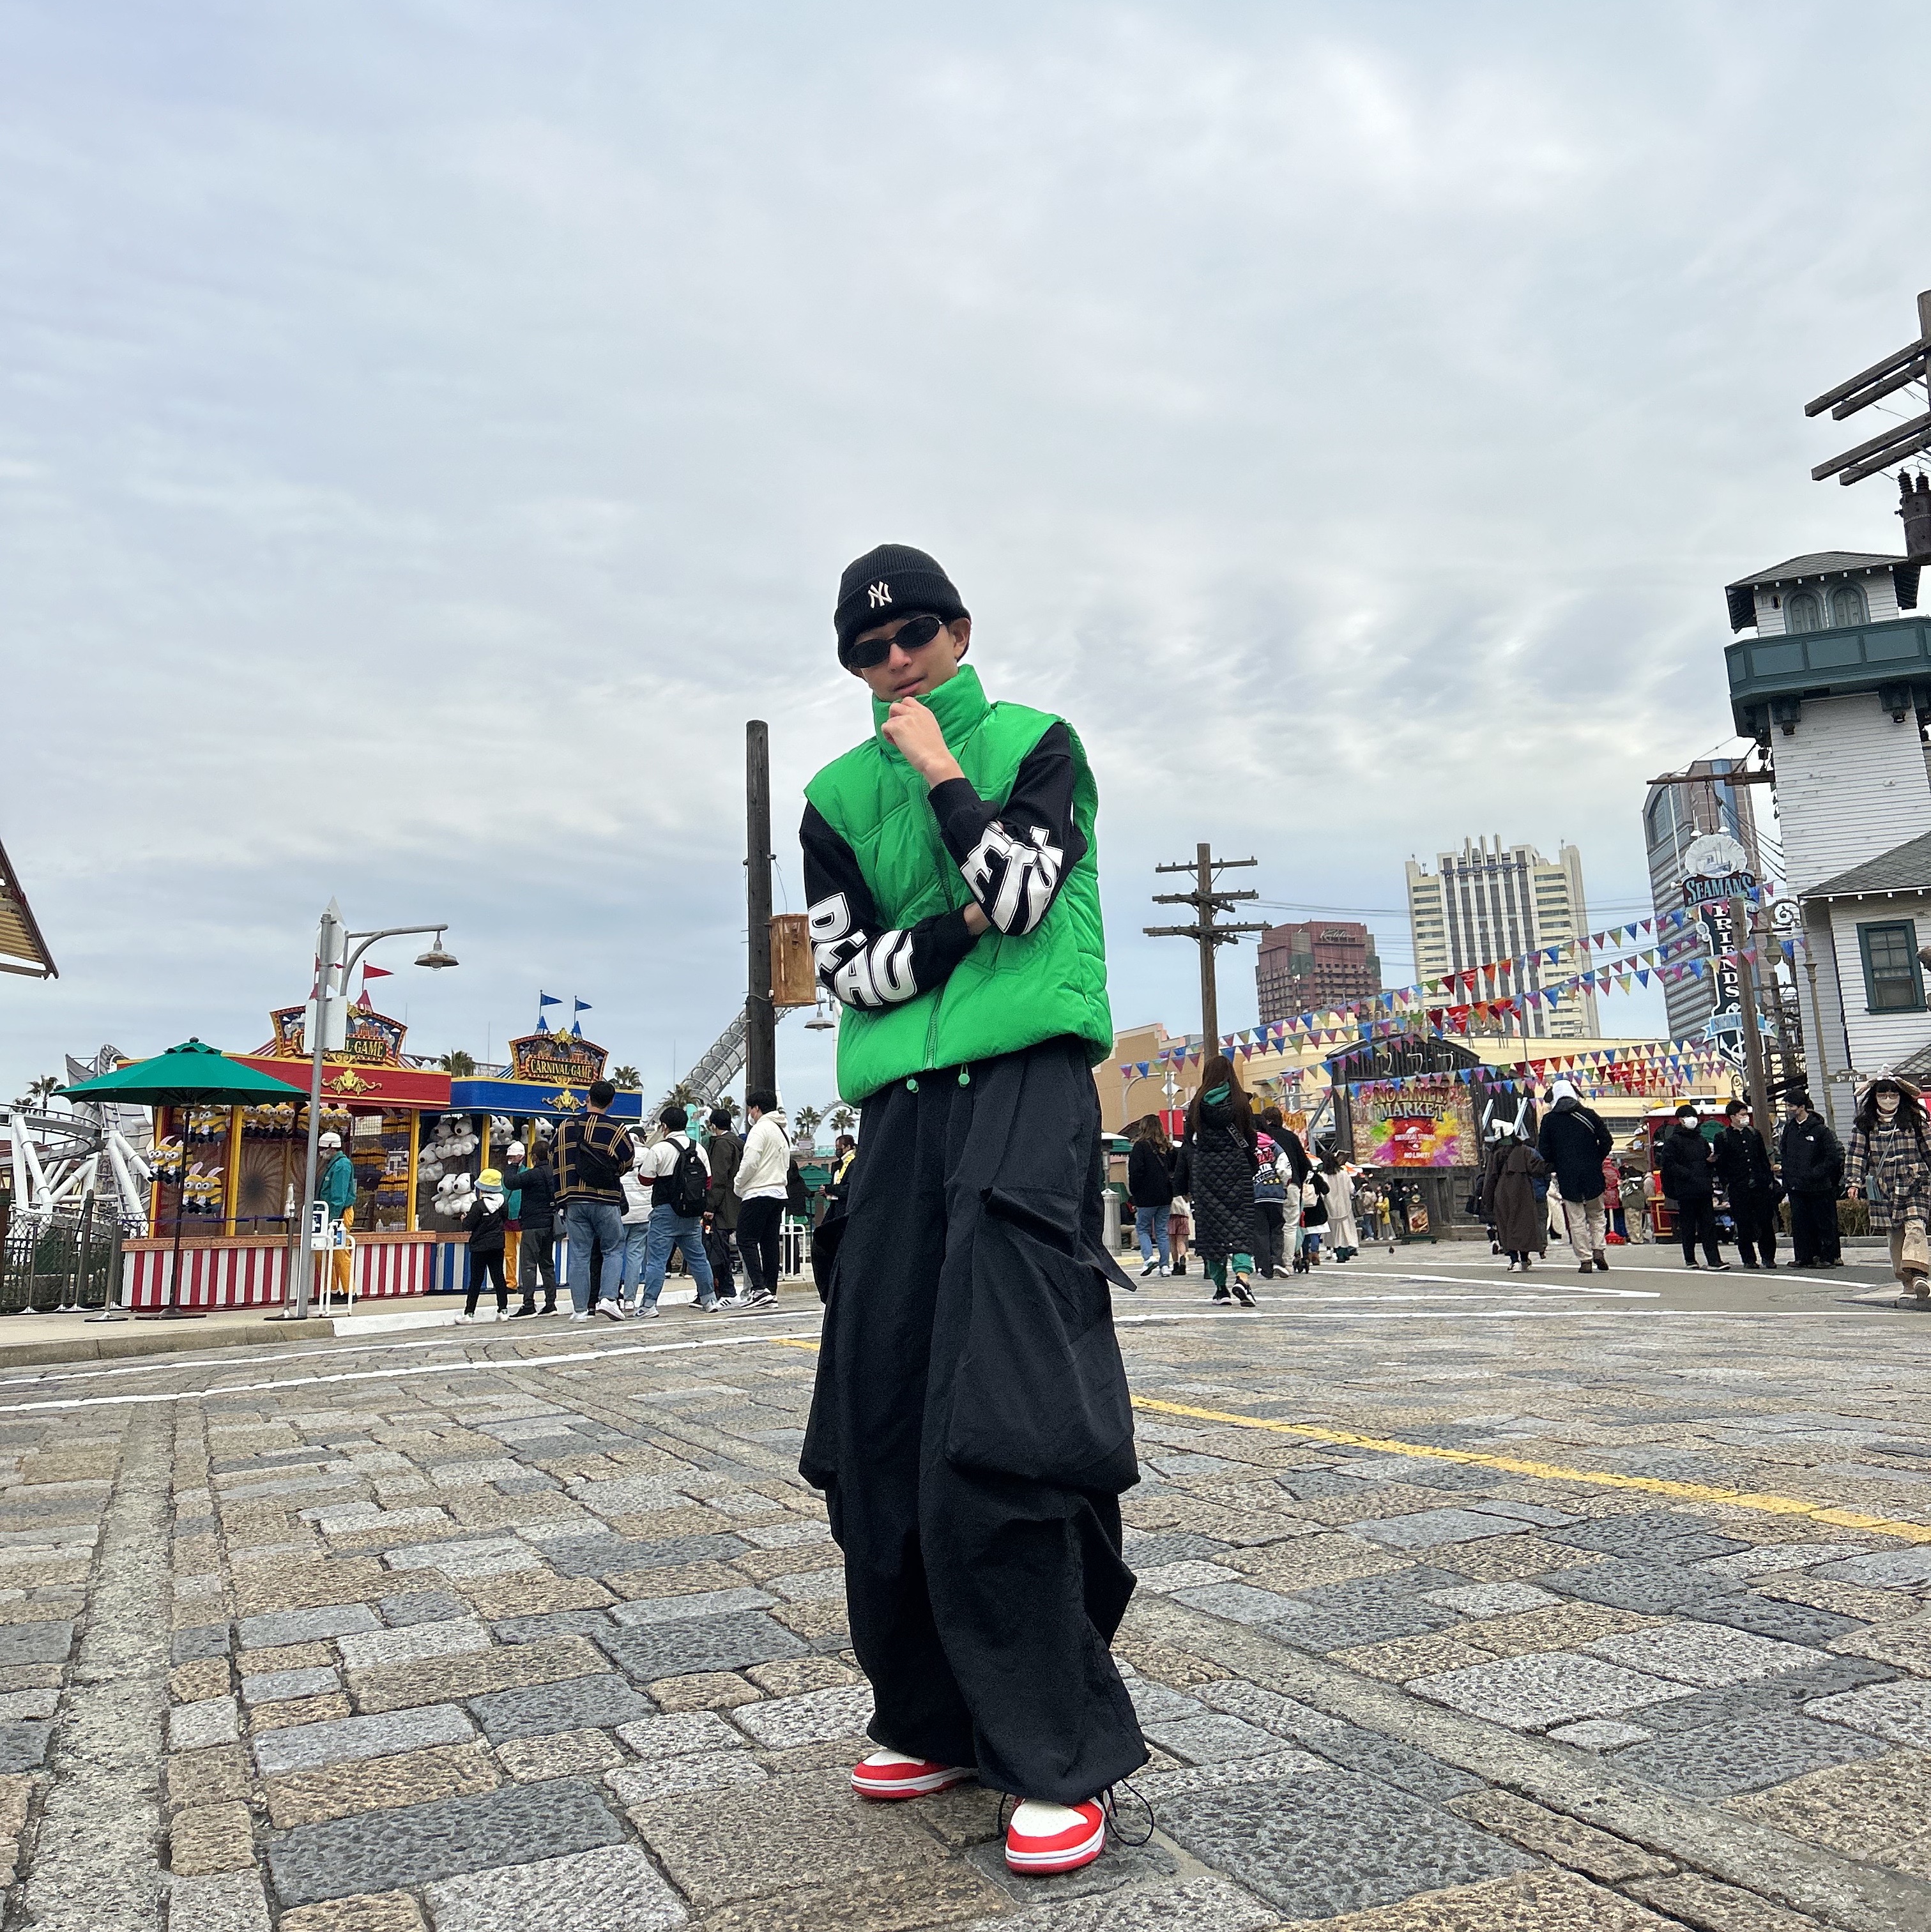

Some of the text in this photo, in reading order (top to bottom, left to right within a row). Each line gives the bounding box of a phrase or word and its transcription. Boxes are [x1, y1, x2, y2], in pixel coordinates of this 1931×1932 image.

[868, 581, 892, 608] NY
[354, 1039, 384, 1057] GAME
[530, 1058, 593, 1079] CARNIVAL GAME
[1373, 1086, 1396, 1104] NO
[1380, 1101, 1446, 1121] MARKET
